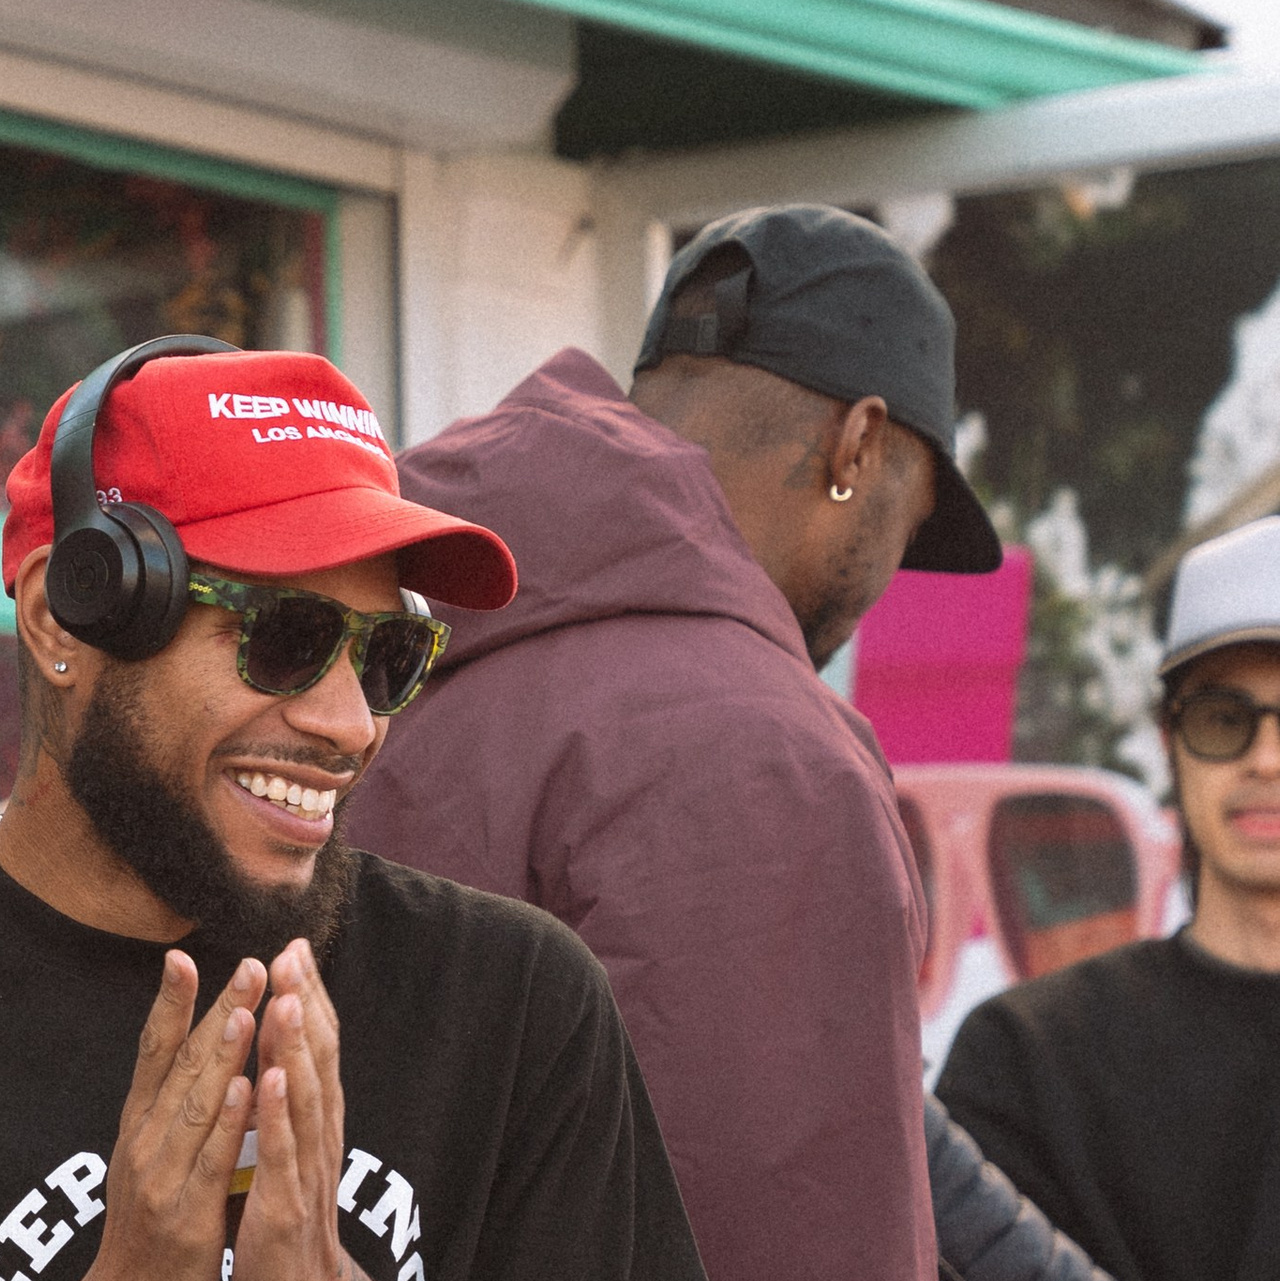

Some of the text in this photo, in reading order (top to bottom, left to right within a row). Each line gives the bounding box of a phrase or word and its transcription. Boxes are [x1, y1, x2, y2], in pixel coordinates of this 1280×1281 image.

[208, 393, 384, 440] KEEP WINNIN
[252, 426, 302, 443] LOS
[189, 582, 213, 594] goodr
